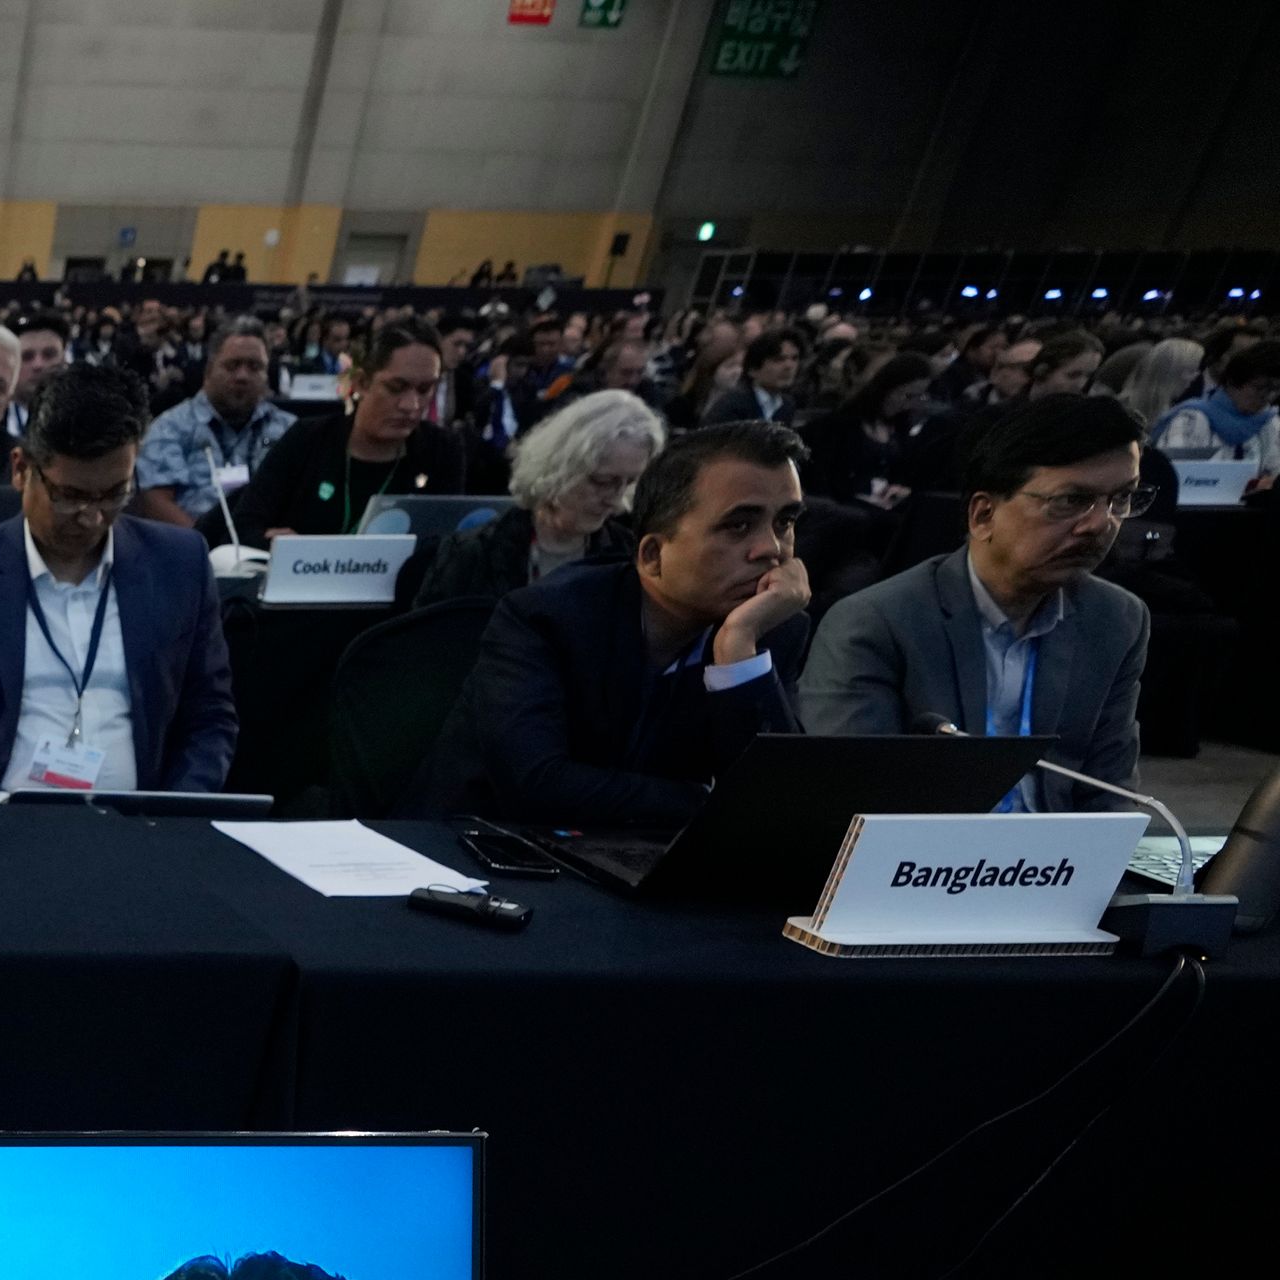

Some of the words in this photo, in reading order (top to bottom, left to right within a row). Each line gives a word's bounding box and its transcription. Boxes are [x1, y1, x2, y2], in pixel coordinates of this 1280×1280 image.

[716, 40, 777, 71] EXIT
[292, 558, 331, 574] Cook
[334, 558, 389, 574] Islands
[890, 857, 1075, 895] Bangladesh
